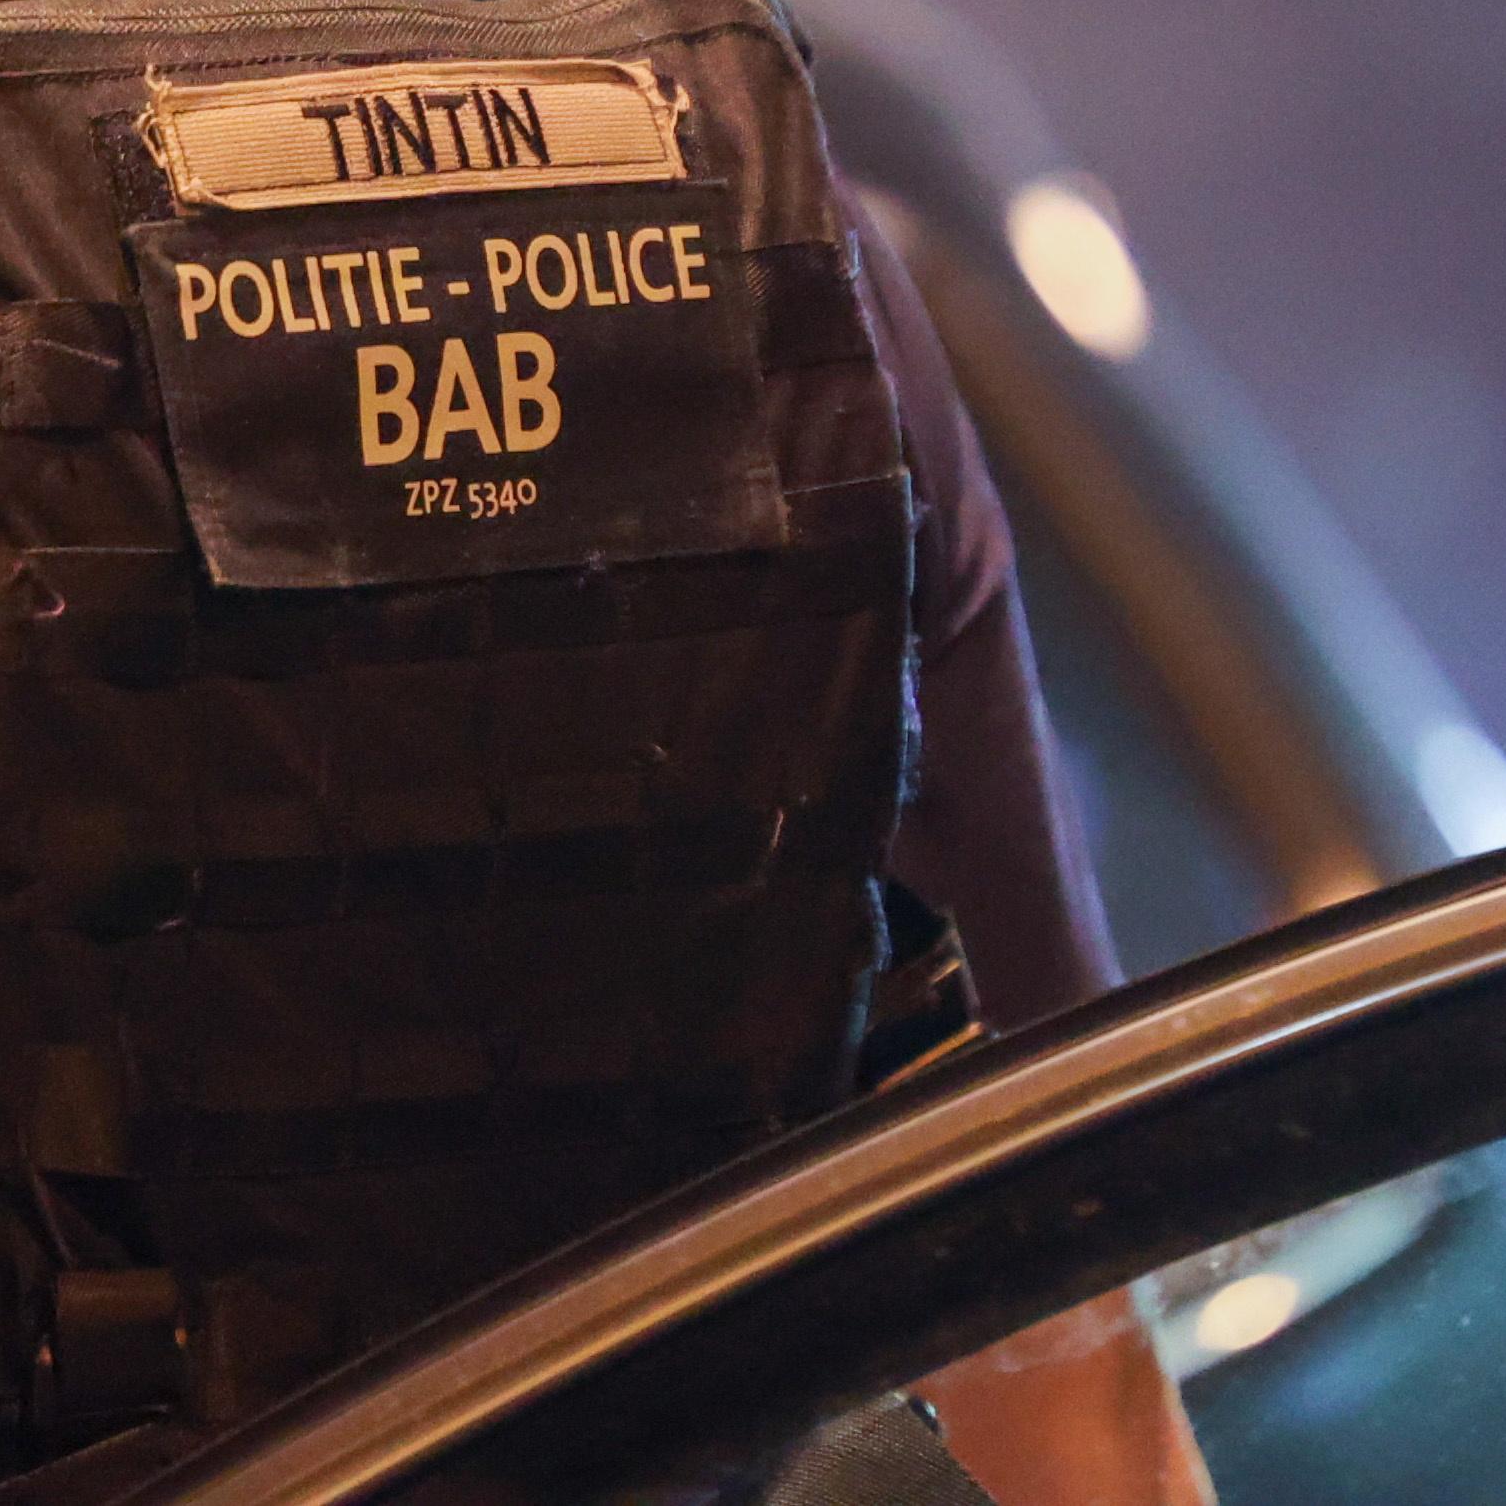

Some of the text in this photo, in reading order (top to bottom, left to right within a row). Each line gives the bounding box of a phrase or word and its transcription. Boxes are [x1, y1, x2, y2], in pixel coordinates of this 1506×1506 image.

[302, 87, 550, 181] TINTIN
[177, 247, 430, 340] POLITIE
[484, 225, 711, 314] POLICE
[356, 331, 562, 467] BAB
[404, 478, 537, 520] ZPZ 5340
